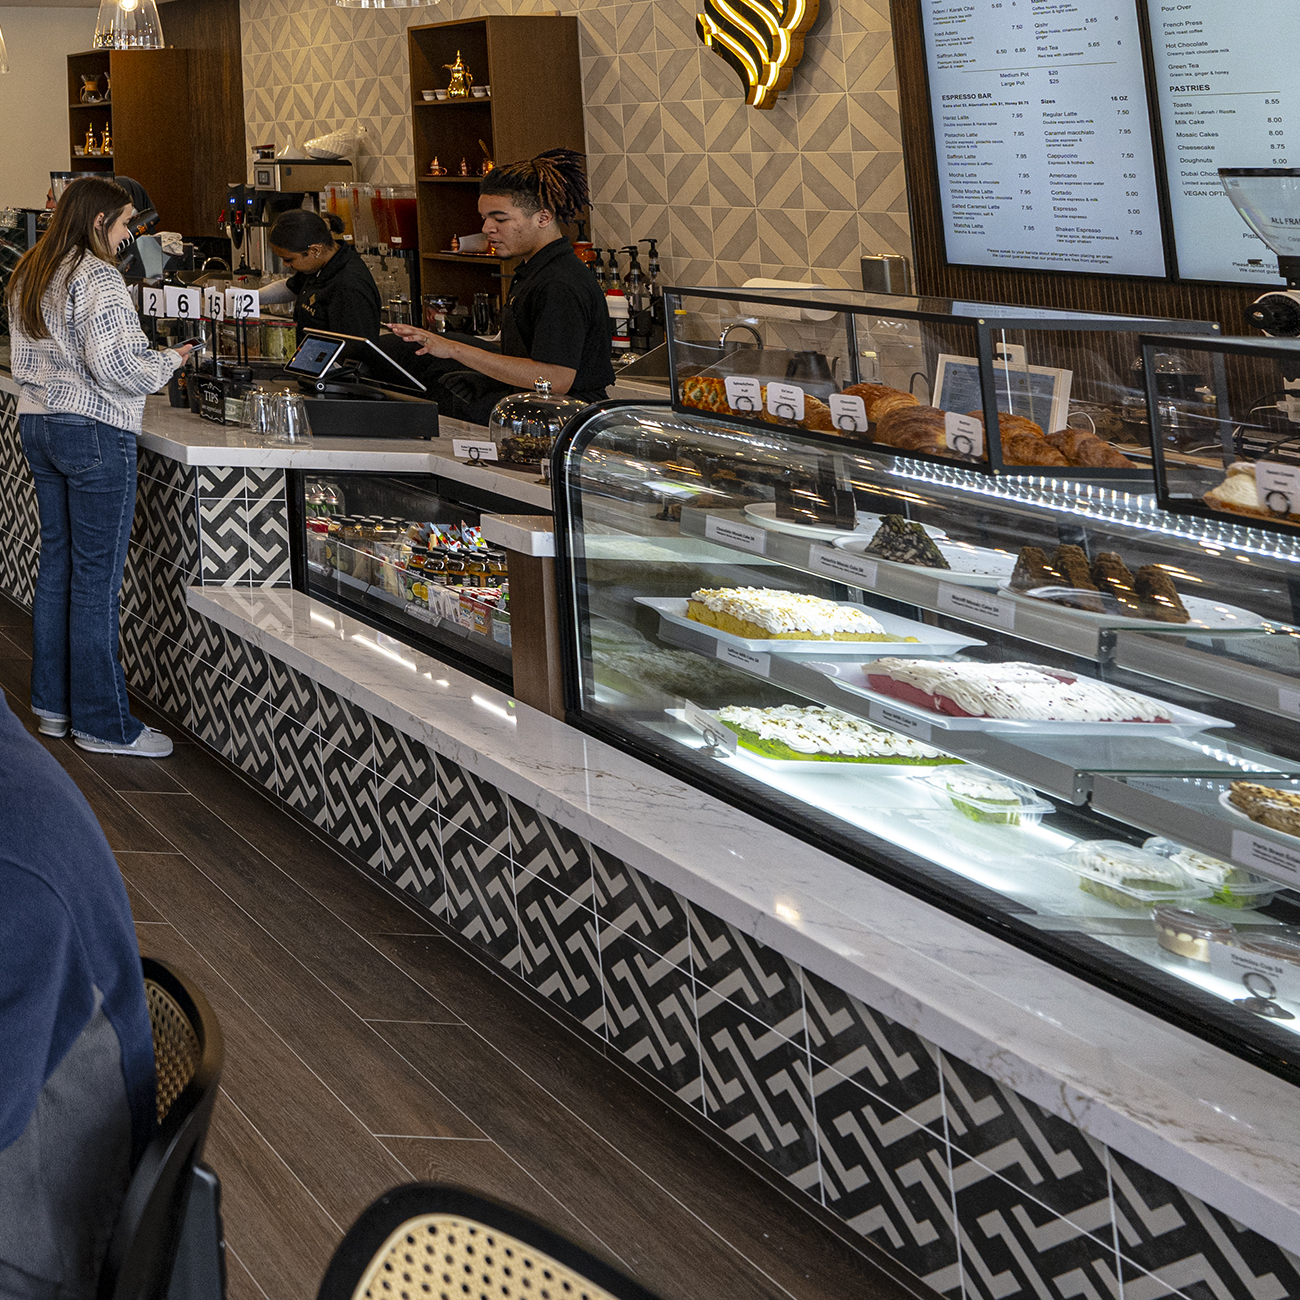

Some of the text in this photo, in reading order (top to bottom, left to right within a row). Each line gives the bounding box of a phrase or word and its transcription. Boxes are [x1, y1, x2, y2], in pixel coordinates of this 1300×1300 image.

[941, 92, 992, 101] ESPRESSO BAR
[1169, 84, 1211, 92] PASTRIES
[149, 292, 157, 312] 2
[177, 294, 189, 313] 6
[208, 294, 221, 315] 15
[203, 390, 219, 405] TIPS
